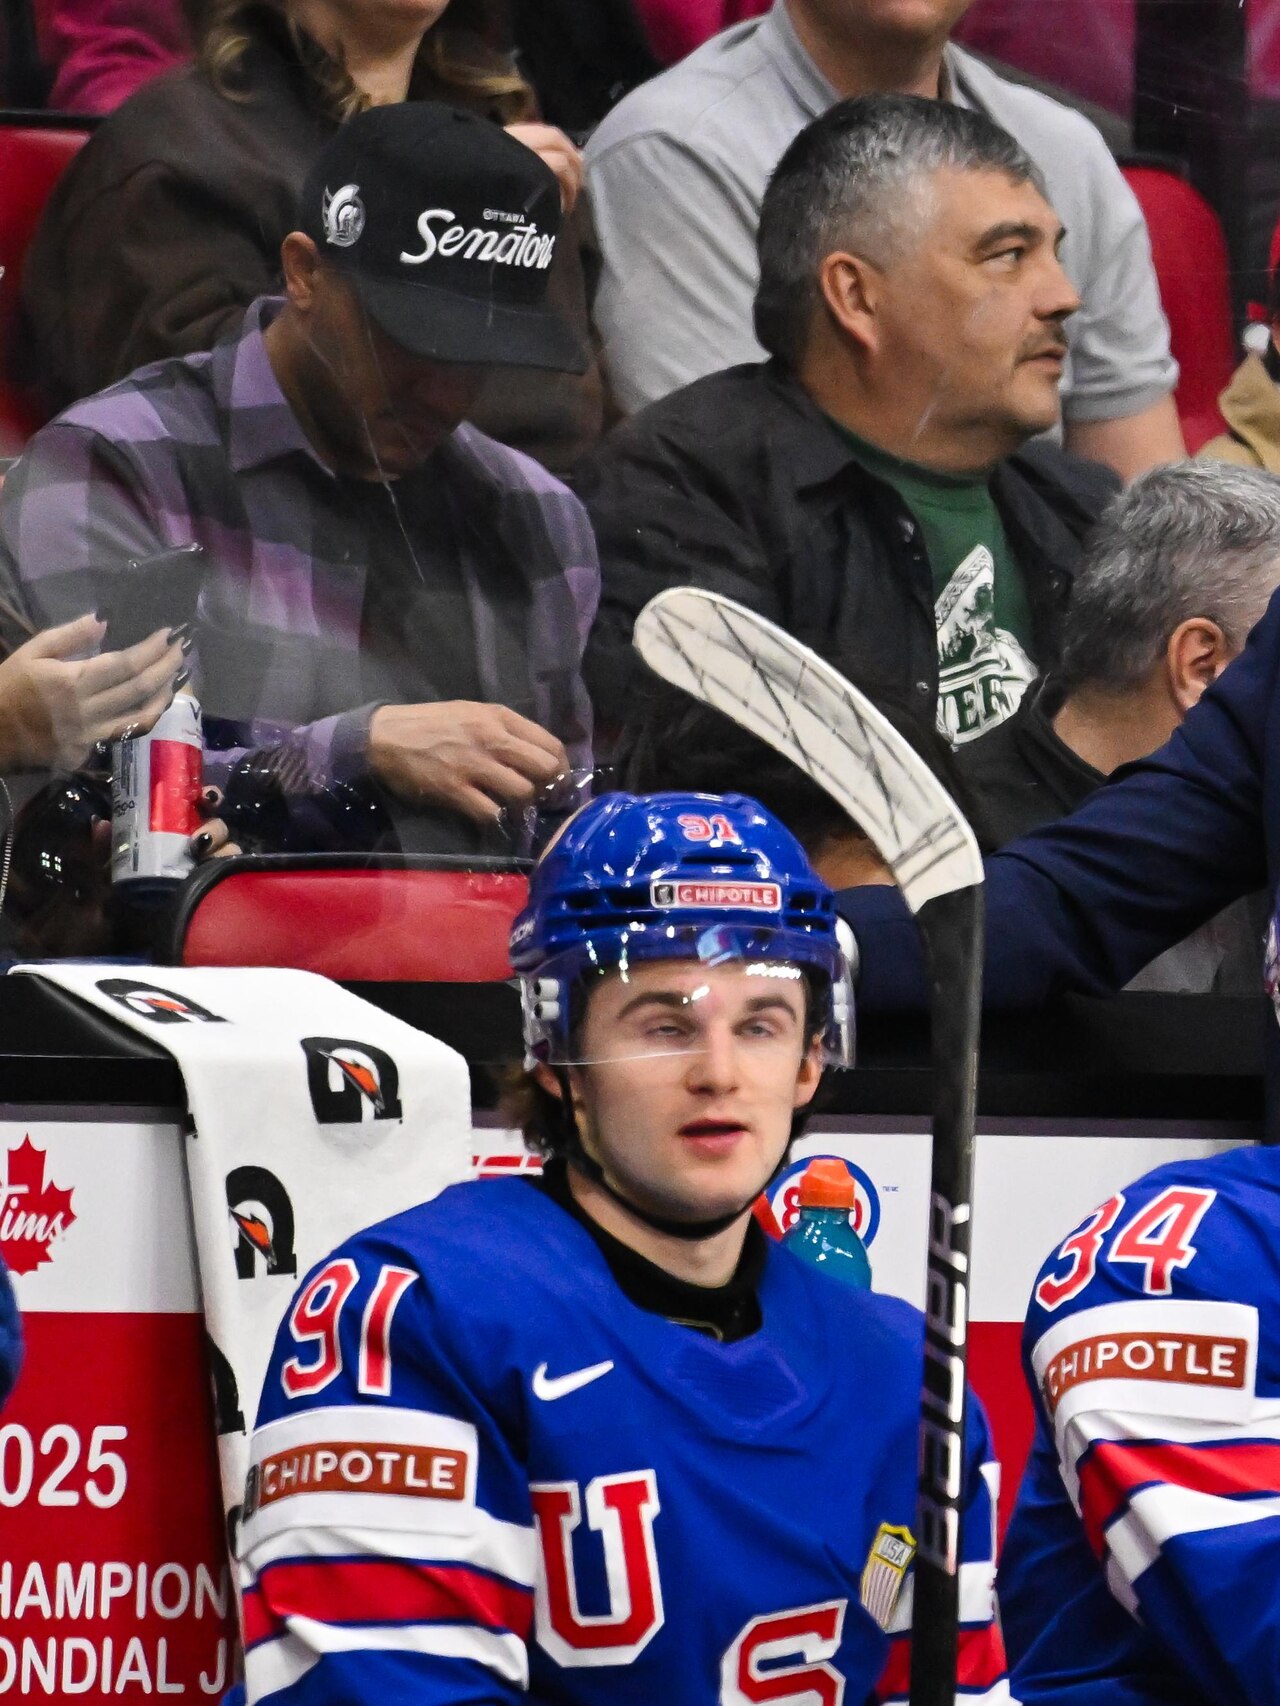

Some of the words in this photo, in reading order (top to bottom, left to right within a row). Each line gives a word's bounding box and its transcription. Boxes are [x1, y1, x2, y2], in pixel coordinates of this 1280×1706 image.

[677, 813, 743, 843] 91
[680, 885, 774, 906] CHIPOTLE
[1036, 1185, 1218, 1313] 34
[281, 1258, 419, 1400] 91
[1049, 1339, 1237, 1398] CHIPOTLE
[262, 1450, 458, 1495] CHIPOTLE
